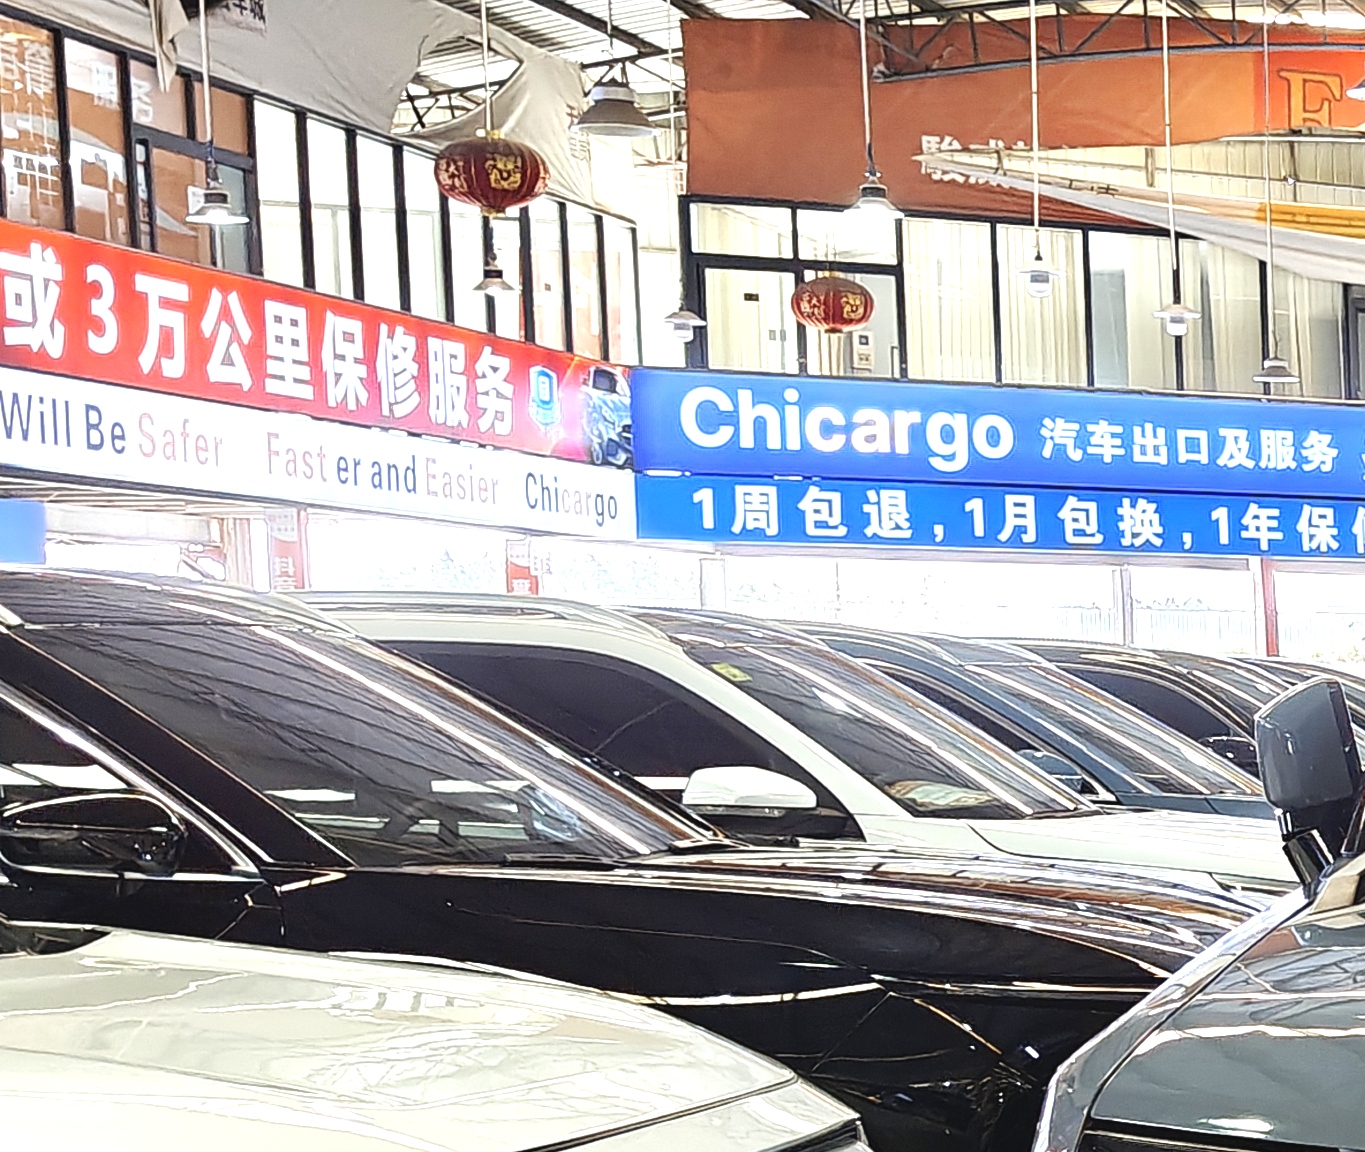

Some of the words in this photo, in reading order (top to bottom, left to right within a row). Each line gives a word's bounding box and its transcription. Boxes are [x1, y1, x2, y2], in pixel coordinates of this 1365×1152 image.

[0, 390, 71, 448] Will
[84, 403, 127, 454] Be
[138, 412, 223, 467] Safer
[372, 455, 417, 494] and
[426, 457, 500, 505] Easier
[525, 471, 618, 528] Chicargo
[680, 386, 1015, 473] Chicargo
[1040, 417, 1339, 474] 汽车出口及服务
